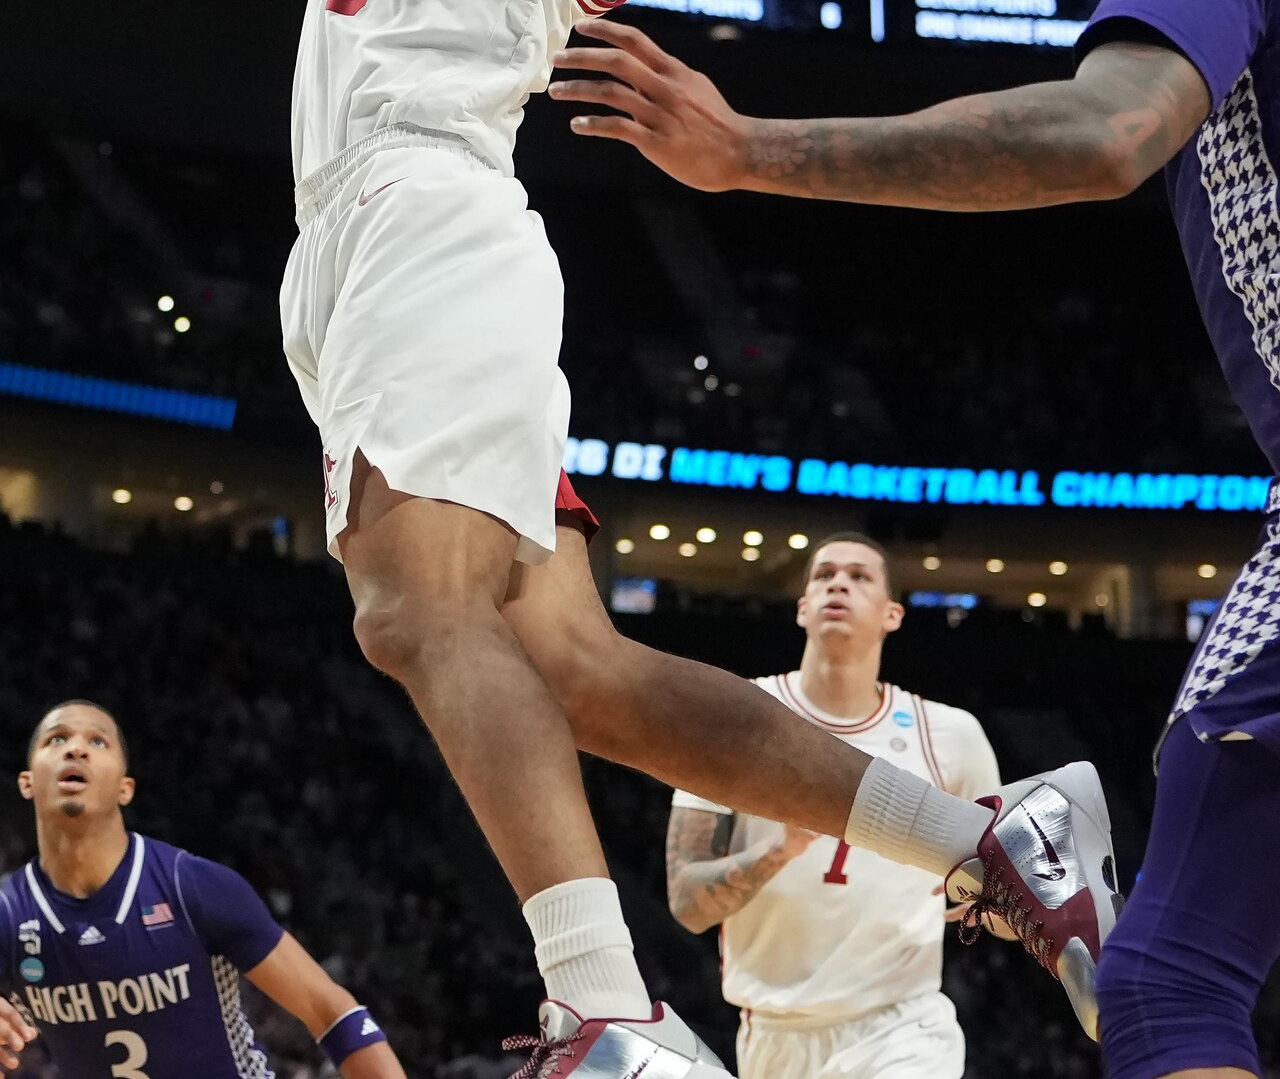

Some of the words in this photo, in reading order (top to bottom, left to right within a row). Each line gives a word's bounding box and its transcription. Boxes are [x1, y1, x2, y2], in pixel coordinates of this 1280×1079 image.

[612, 441, 667, 481] DI
[670, 446, 792, 492] MEN'S
[796, 458, 1046, 506] BASKETBALL
[25, 982, 98, 1025] HIGH
[97, 963, 190, 1020] POINT
